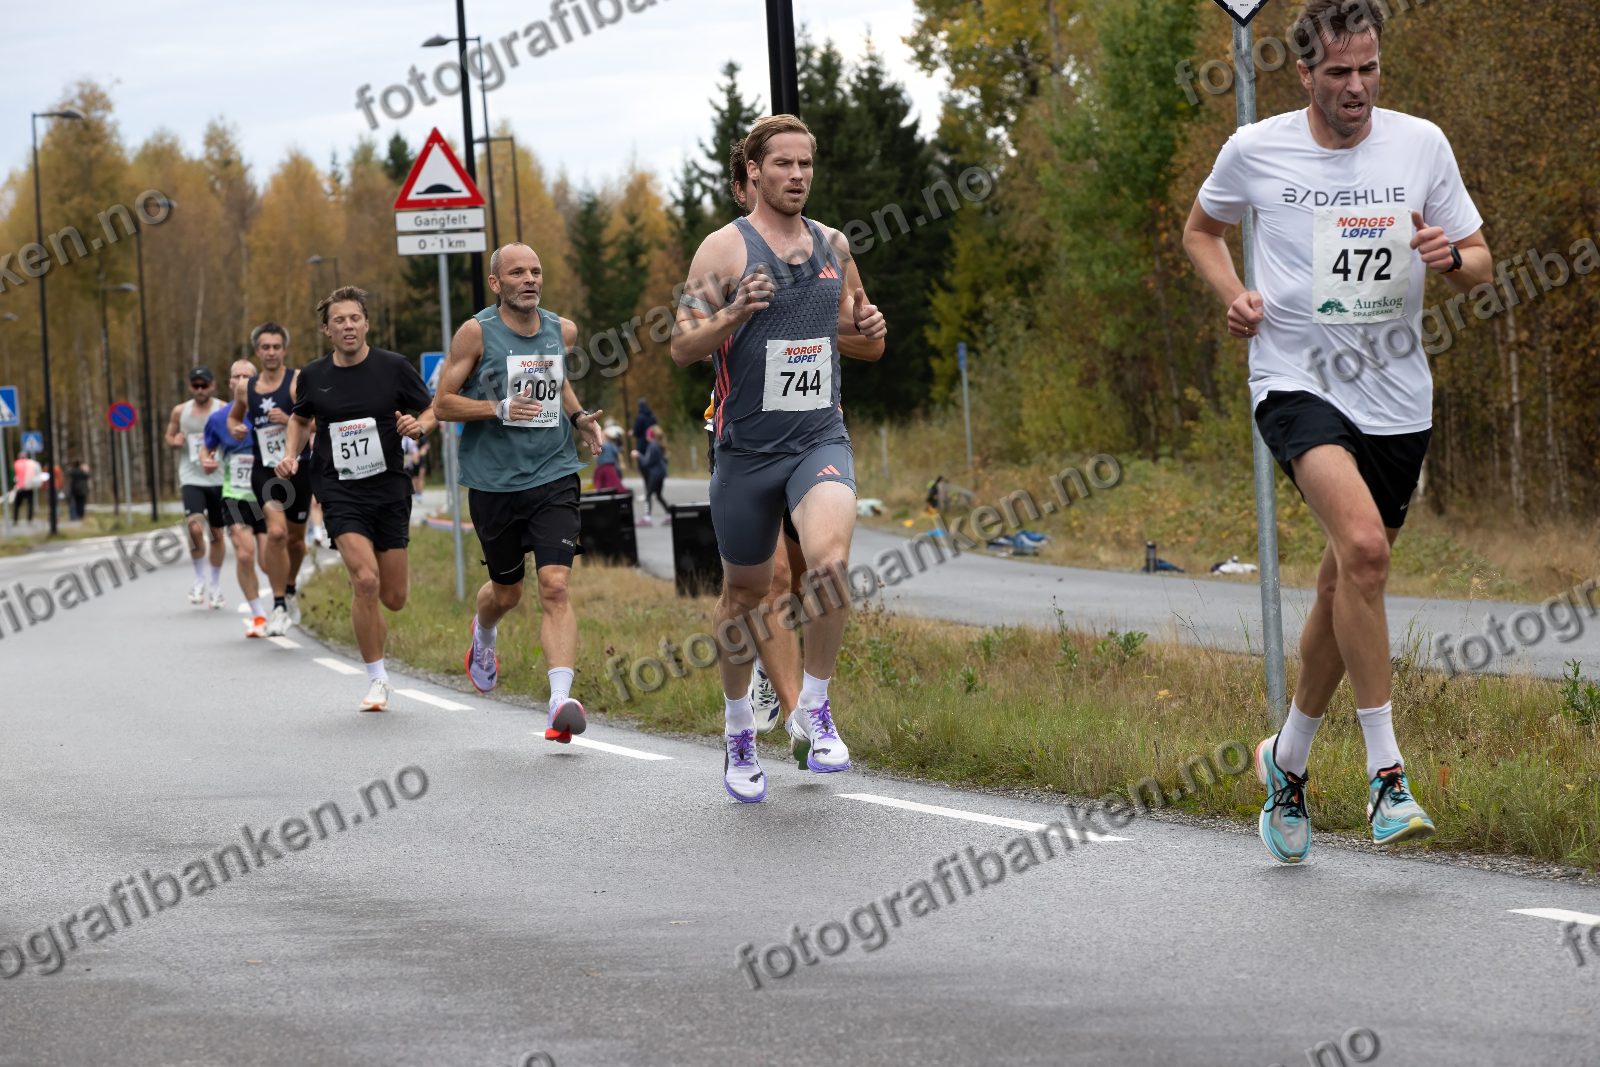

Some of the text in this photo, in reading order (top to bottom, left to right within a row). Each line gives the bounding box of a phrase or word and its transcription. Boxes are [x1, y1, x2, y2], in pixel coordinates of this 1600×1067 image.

[414, 214, 468, 227] Gangfelt
[1336, 216, 1396, 228] NORGES
[1341, 228, 1387, 239] LØPET
[418, 239, 427, 250] 0
[439, 239, 445, 248] 1
[447, 238, 467, 248] km
[1332, 247, 1392, 282] 472
[1353, 296, 1403, 310] Aurskog
[784, 345, 823, 356] NORGES
[519, 360, 554, 368] NORGES
[787, 354, 818, 364] LØPET
[780, 370, 821, 397] 744
[514, 379, 557, 401] 1008
[338, 423, 368, 433] NORGES
[341, 437, 369, 460] 517
